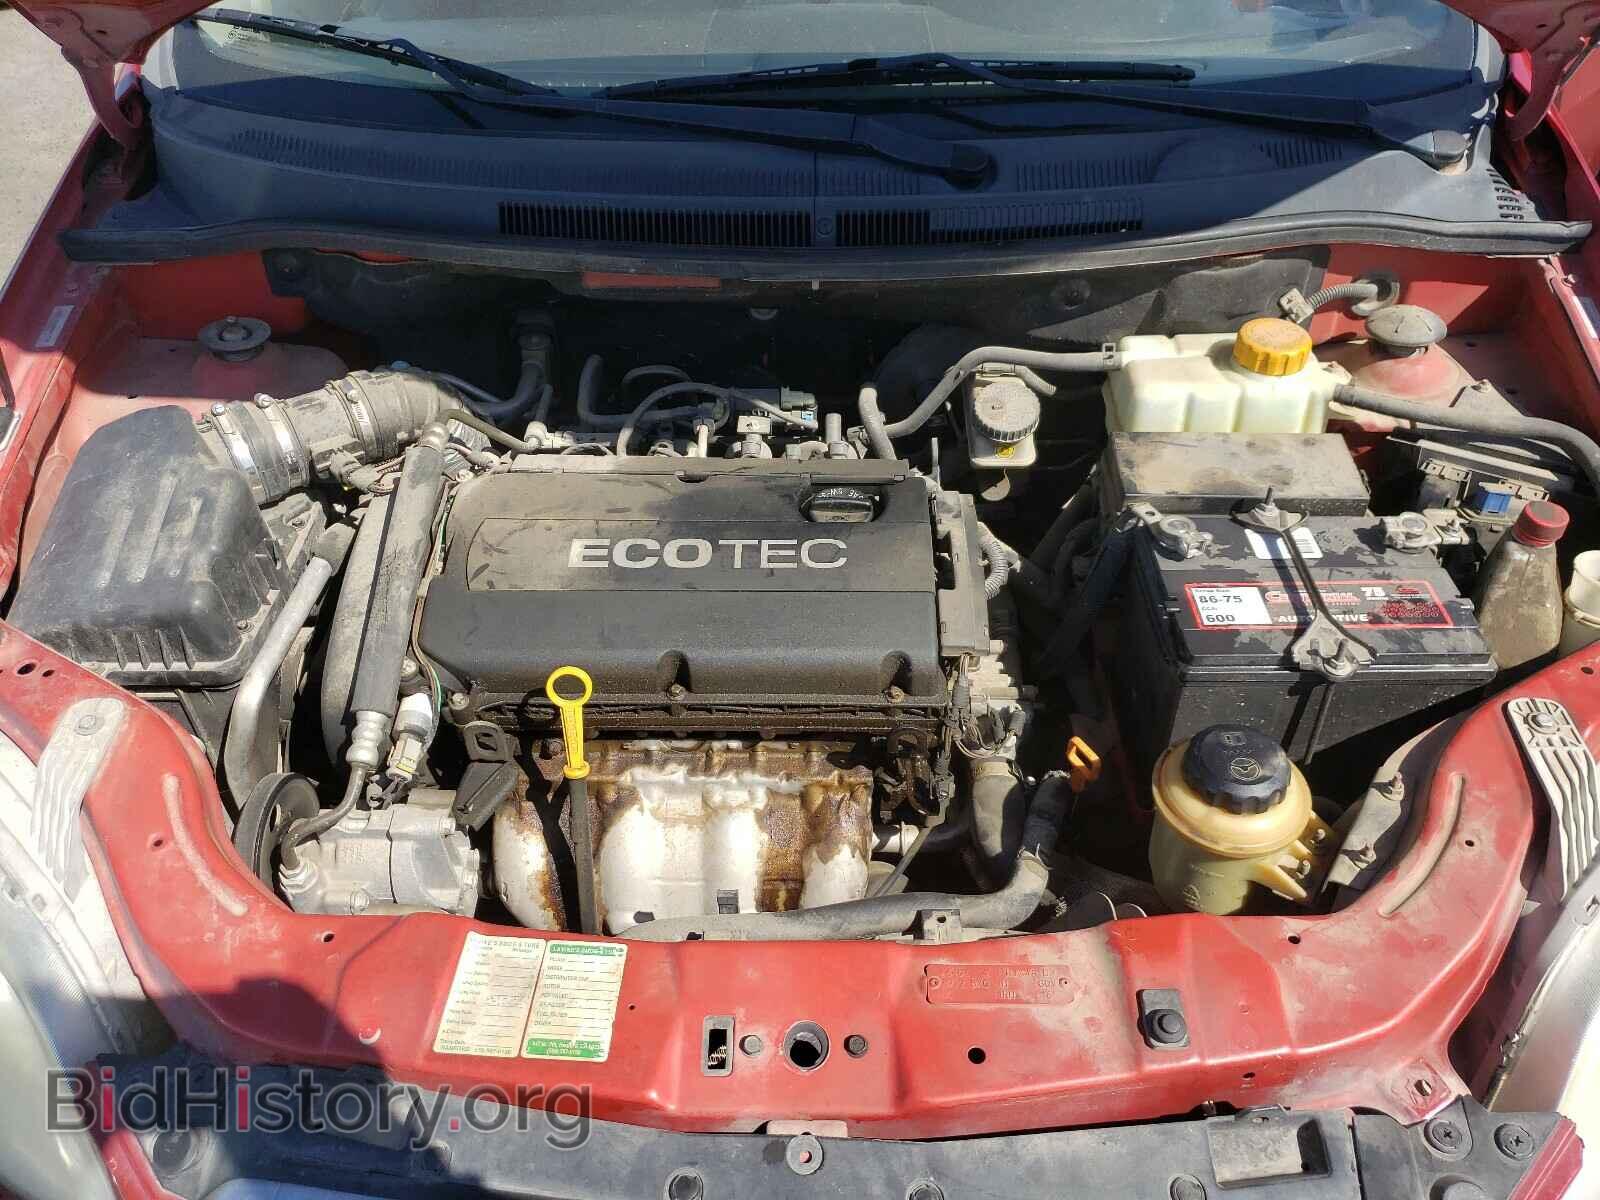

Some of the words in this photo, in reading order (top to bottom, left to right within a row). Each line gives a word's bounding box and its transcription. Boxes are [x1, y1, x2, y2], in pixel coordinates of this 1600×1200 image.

[568, 538, 848, 569] ECOTEC
[1199, 595, 1243, 604] 86-75
[1206, 614, 1236, 623] 600
